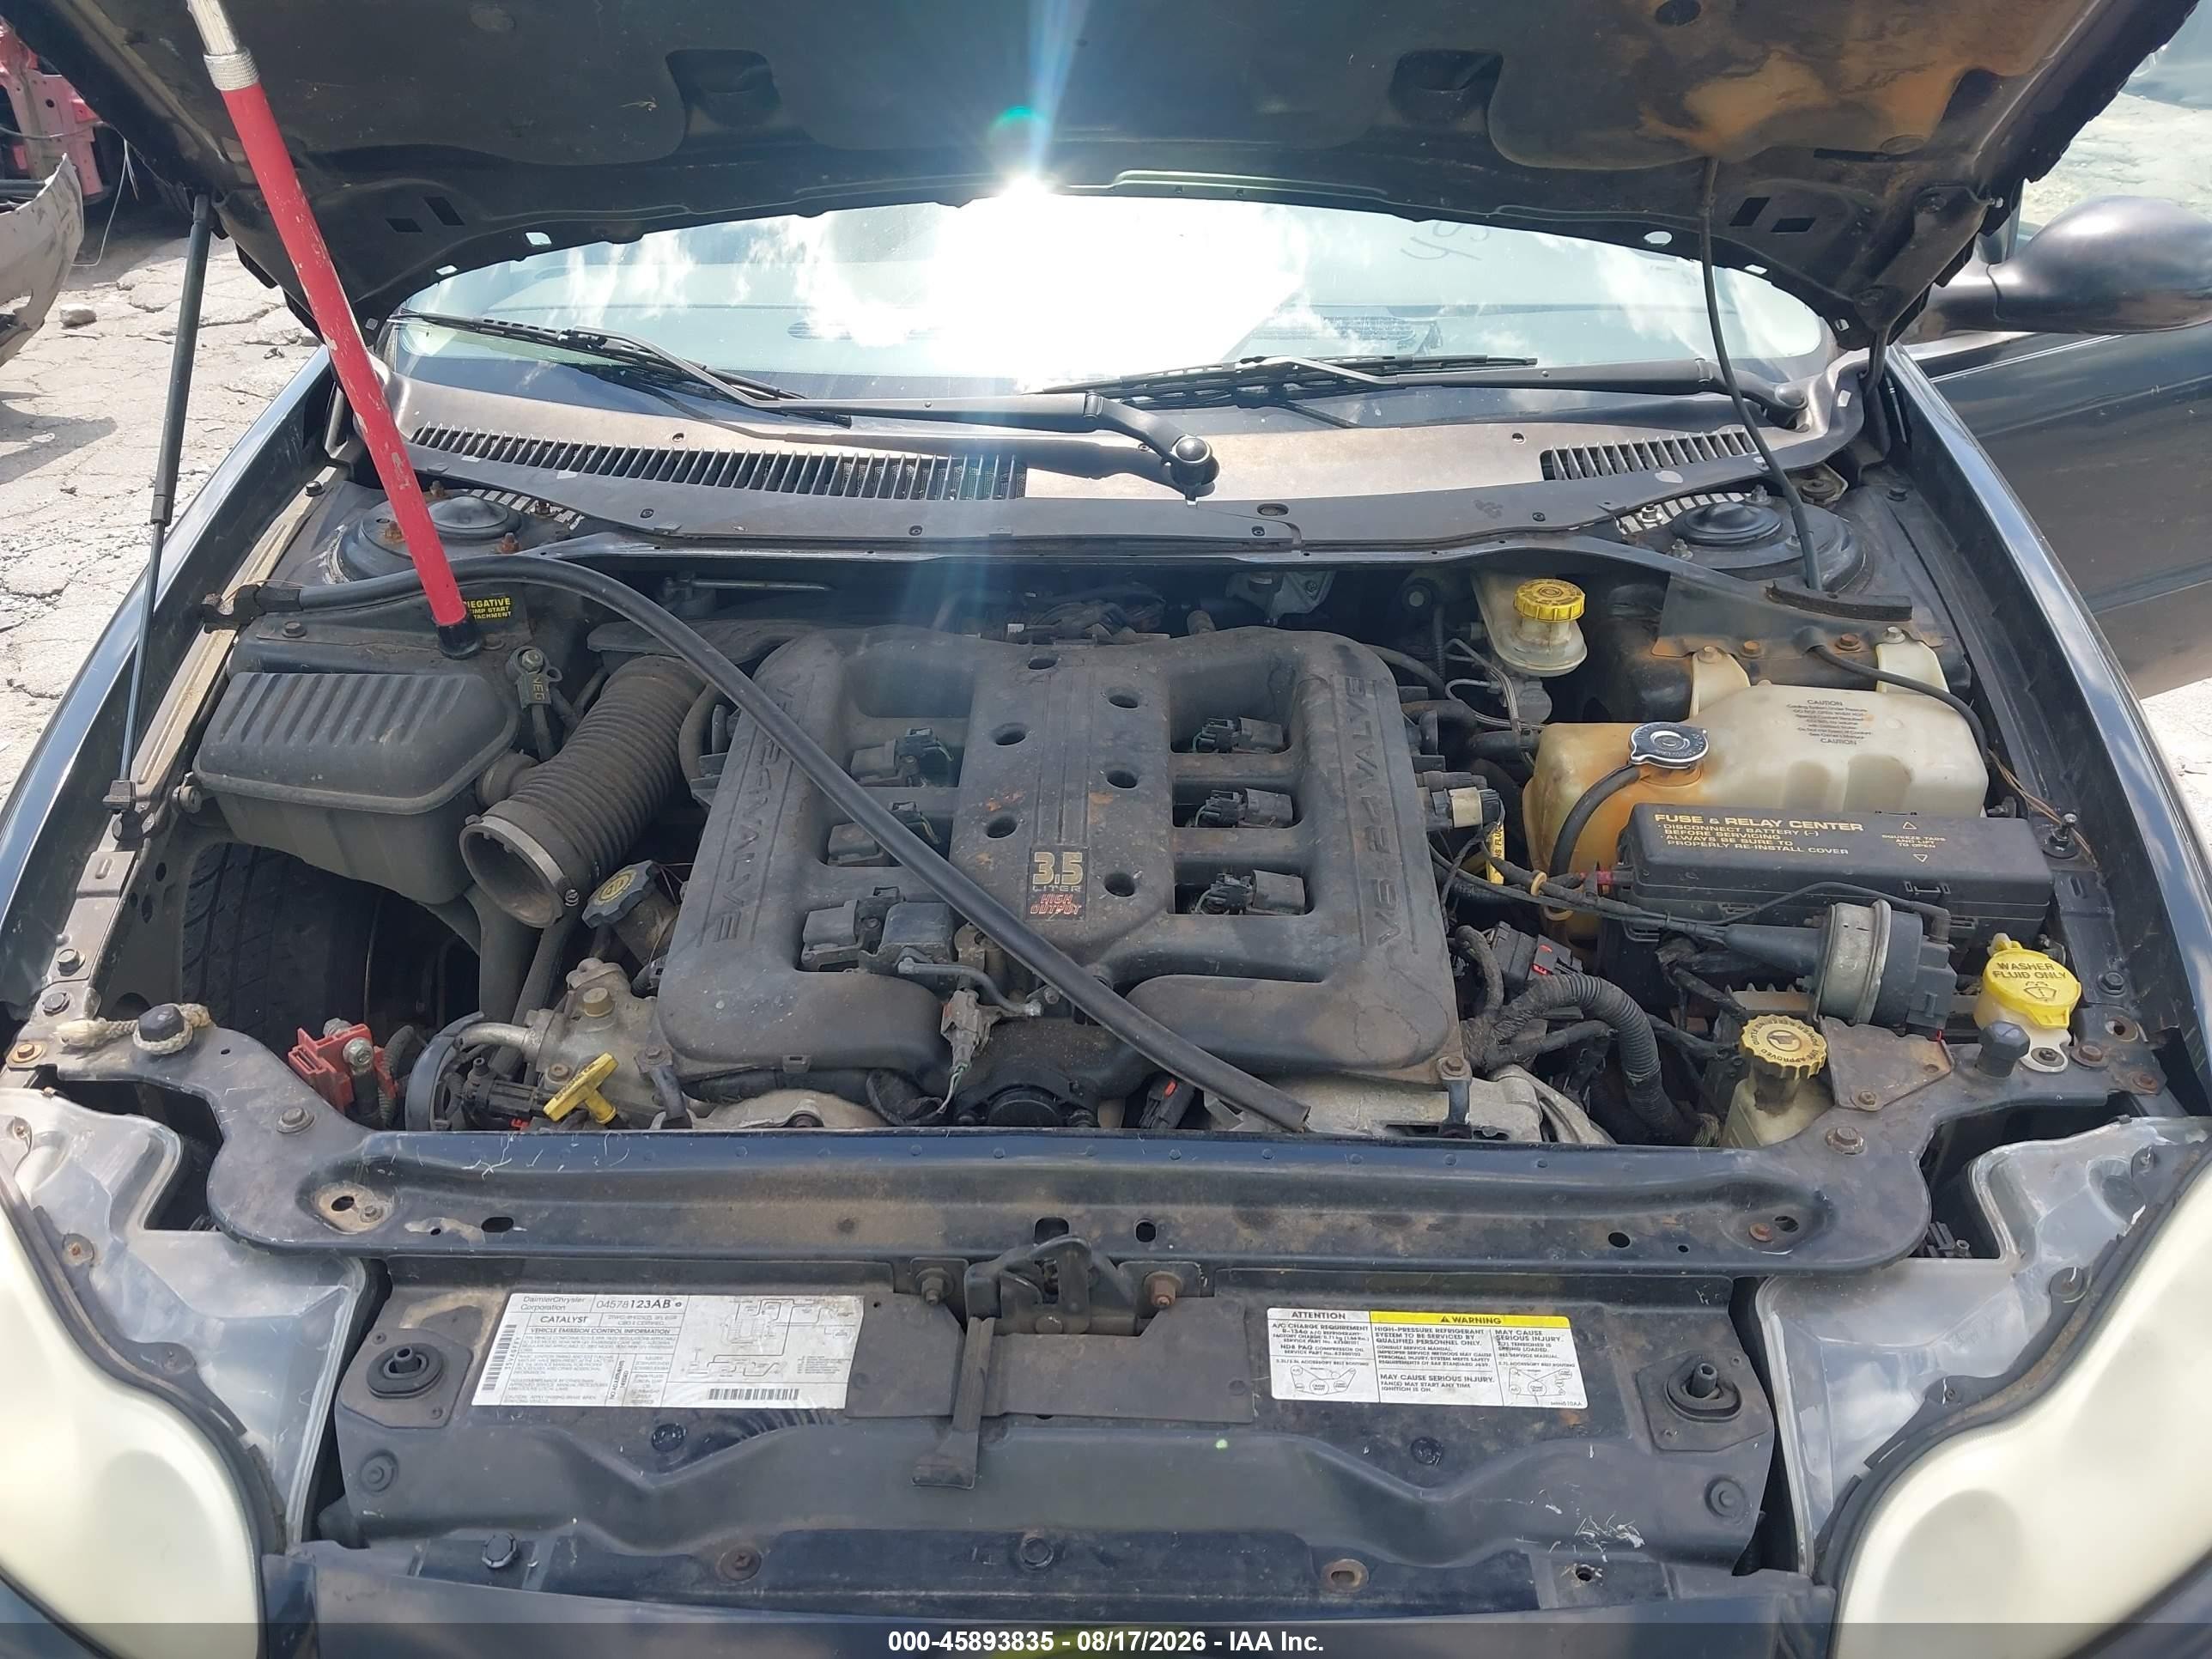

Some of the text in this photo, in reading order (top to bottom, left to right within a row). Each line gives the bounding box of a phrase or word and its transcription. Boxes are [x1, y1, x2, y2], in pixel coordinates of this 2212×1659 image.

[532, 677, 545, 701] NEG
[1344, 675, 1379, 790] VALVE
[1655, 814, 1704, 824] FUSE
[1725, 817, 1783, 829] RELAY
[1789, 820, 1864, 831] CENTER
[1663, 823, 1741, 833] DISCONNECT
[1667, 840, 1729, 848] PROPERLY
[1735, 843, 1804, 853] RE-INSTALL
[1032, 852, 1083, 884] 3.5
[1040, 893, 1073, 904] HIGH
[1030, 903, 1082, 915] OUTPUT
[1992, 970, 2031, 979] FLUID
[1760, 1048, 1806, 1063] APPROVED
[596, 1299, 671, 1309] 04578123AB
[1291, 1311, 1346, 1320] ATTENTION
